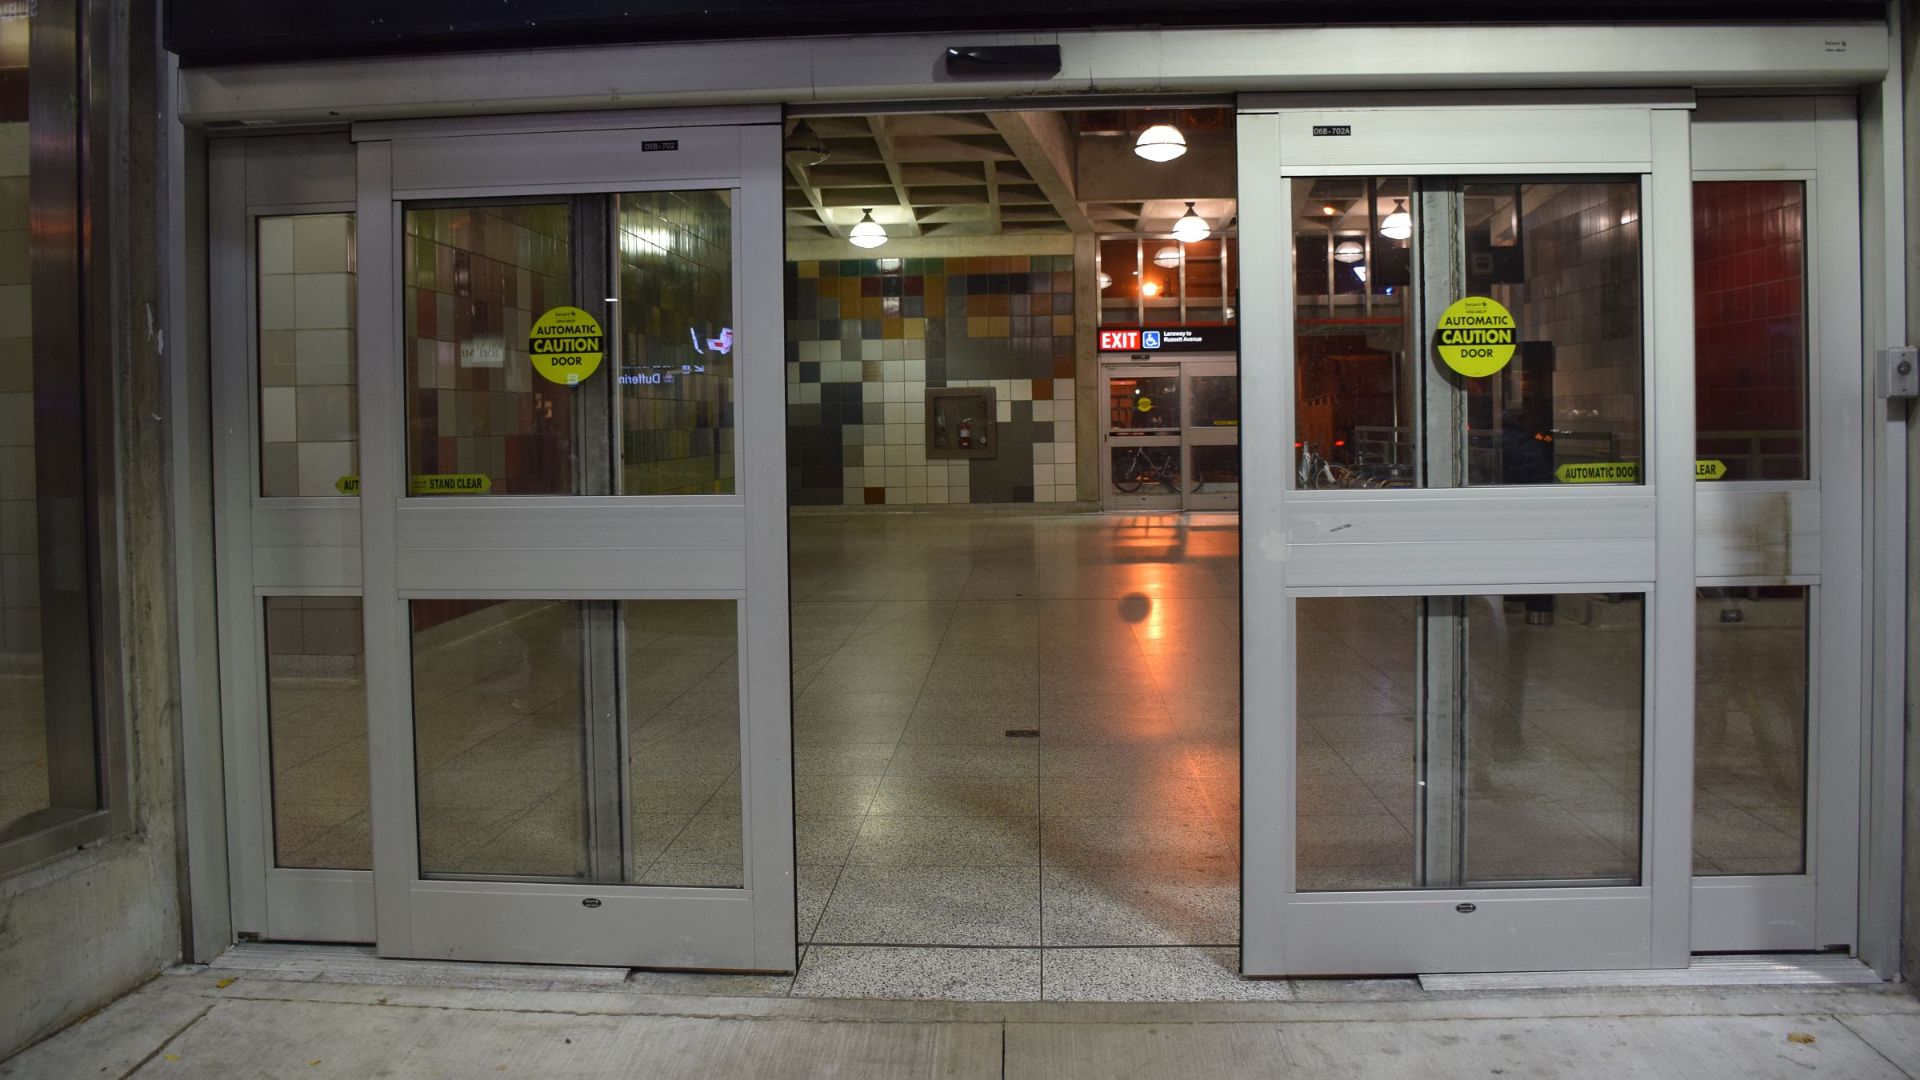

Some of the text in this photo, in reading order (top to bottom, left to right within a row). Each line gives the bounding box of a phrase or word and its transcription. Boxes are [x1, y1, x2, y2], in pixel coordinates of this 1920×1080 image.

[1446, 315, 1508, 325] AUTOMATIC
[537, 325, 596, 335] AUTOMATIC
[1102, 332, 1138, 349] EXIT
[1442, 329, 1511, 344] CAUTION
[534, 338, 599, 353] CAUTION
[1461, 348, 1493, 358] DOOR
[551, 357, 581, 366] DOOR
[1565, 464, 1716, 479] AUTOMATIC DOOR LEAR
[344, 479, 360, 490] AUT
[429, 479, 455, 489] STAND
[457, 478, 483, 488] CLEAR
